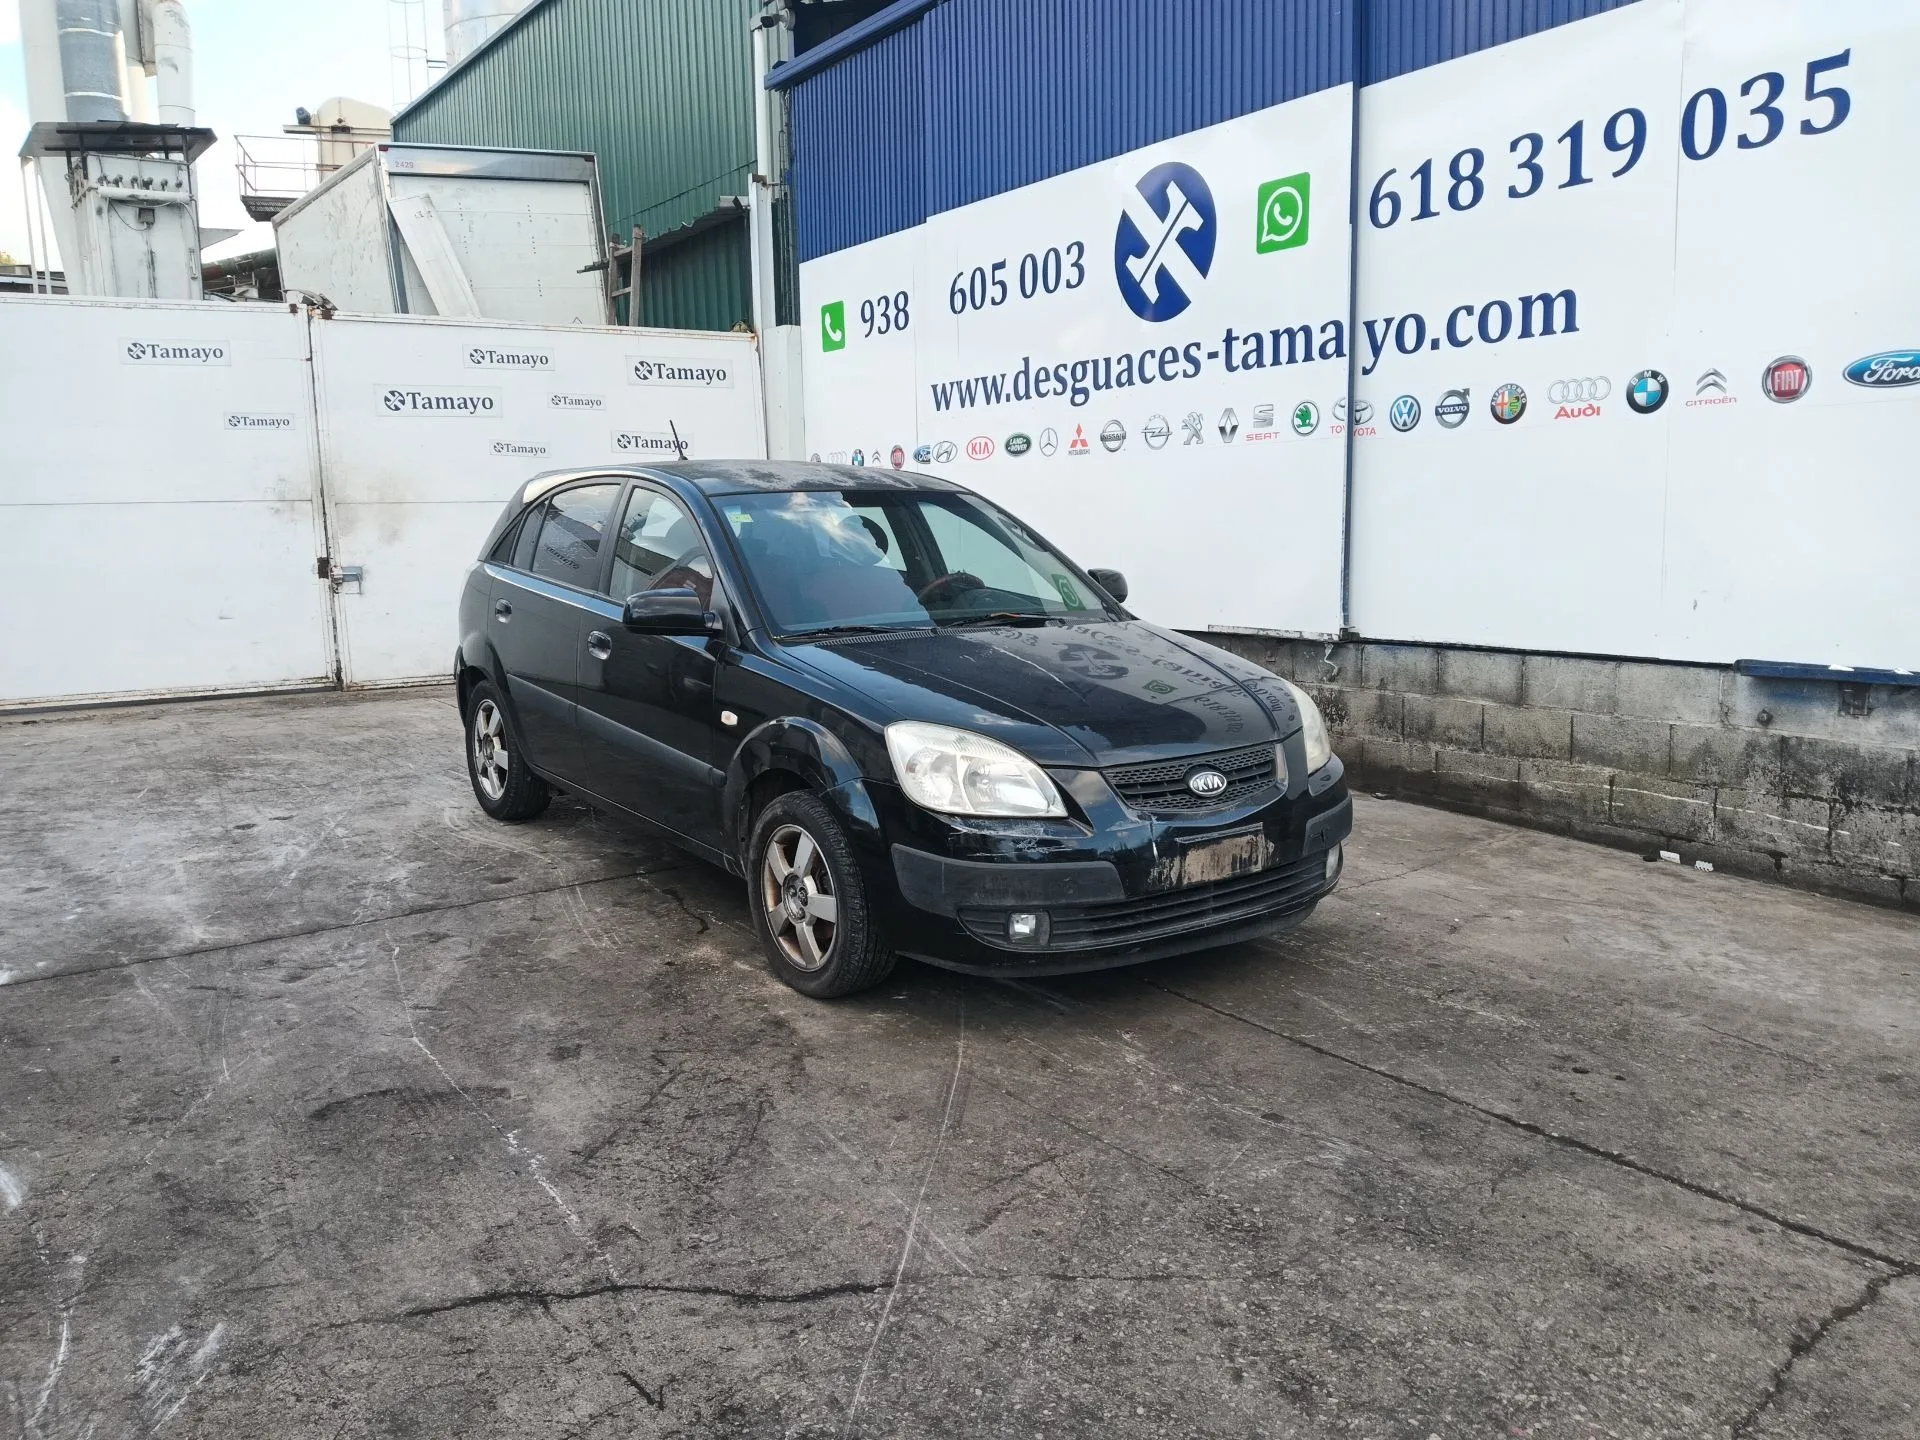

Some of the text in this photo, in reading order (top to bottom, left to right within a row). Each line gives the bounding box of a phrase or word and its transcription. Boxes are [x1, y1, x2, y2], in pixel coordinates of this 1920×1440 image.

[1369, 47, 1852, 229] 618 319 035
[860, 240, 1086, 339] 938 605 003
[146, 343, 224, 362] Tamayo
[486, 350, 549, 368] Tamayo
[653, 362, 727, 386] Tamayo
[1774, 368, 1802, 391] FIAT
[406, 391, 494, 415] Tamayo
[561, 396, 602, 408] Tamayo
[1437, 405, 1468, 414] VOLVO
[1554, 404, 1601, 420] Audi
[240, 416, 290, 429] Tamayo
[631, 435, 688, 452] Tamayo
[1246, 432, 1280, 441] SEAT
[503, 443, 546, 456] Tamayo
[970, 440, 990, 456] KIA
[1197, 776, 1223, 792] KIA
